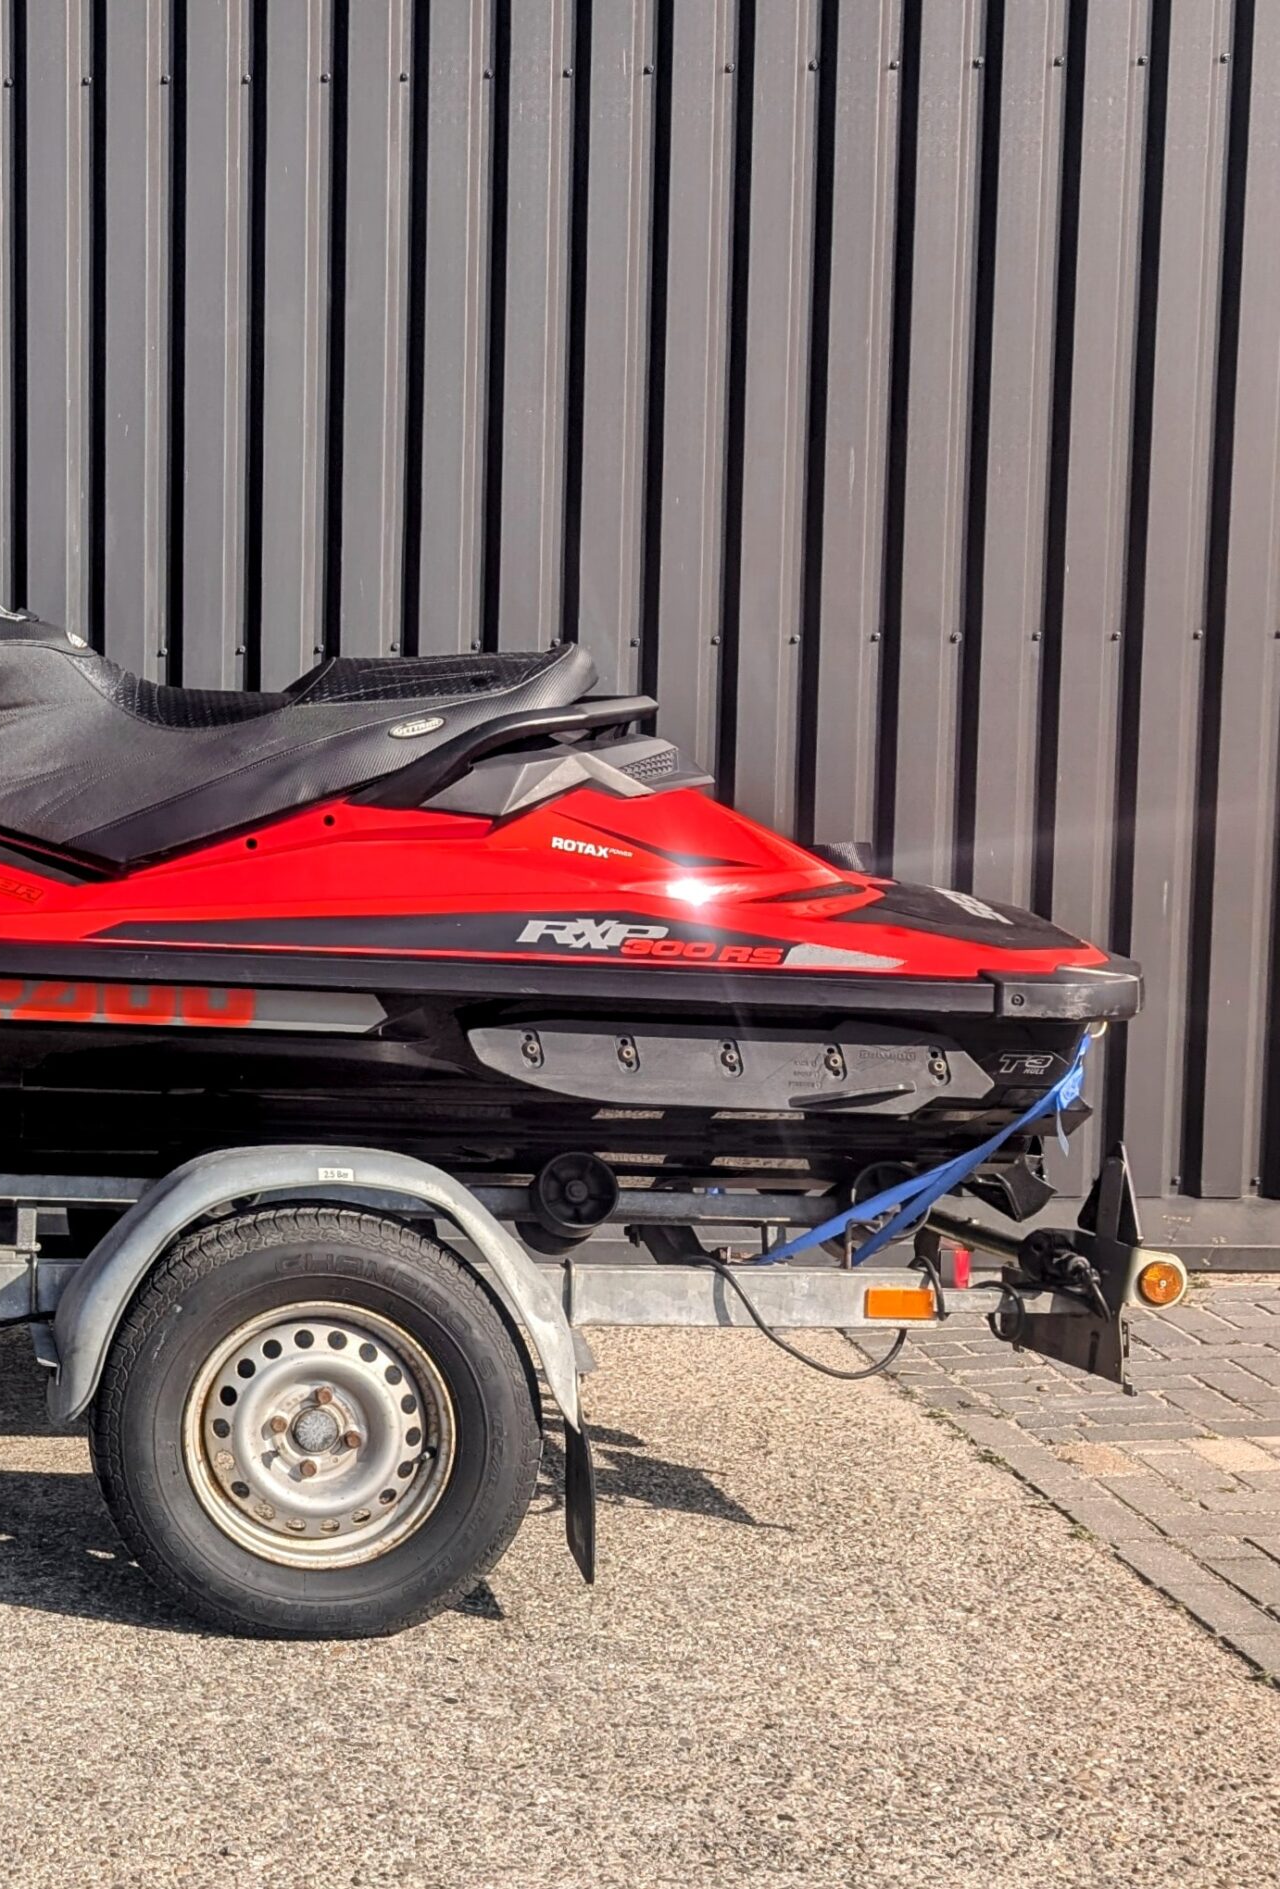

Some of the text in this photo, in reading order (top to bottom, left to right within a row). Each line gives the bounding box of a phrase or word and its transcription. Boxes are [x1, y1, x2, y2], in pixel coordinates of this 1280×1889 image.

[551, 836, 609, 859] ROTAX
[516, 918, 784, 965] RXP 300 RS
[1000, 1054, 1053, 1073] T3
[275, 1252, 470, 1340] CHAMPIRO
